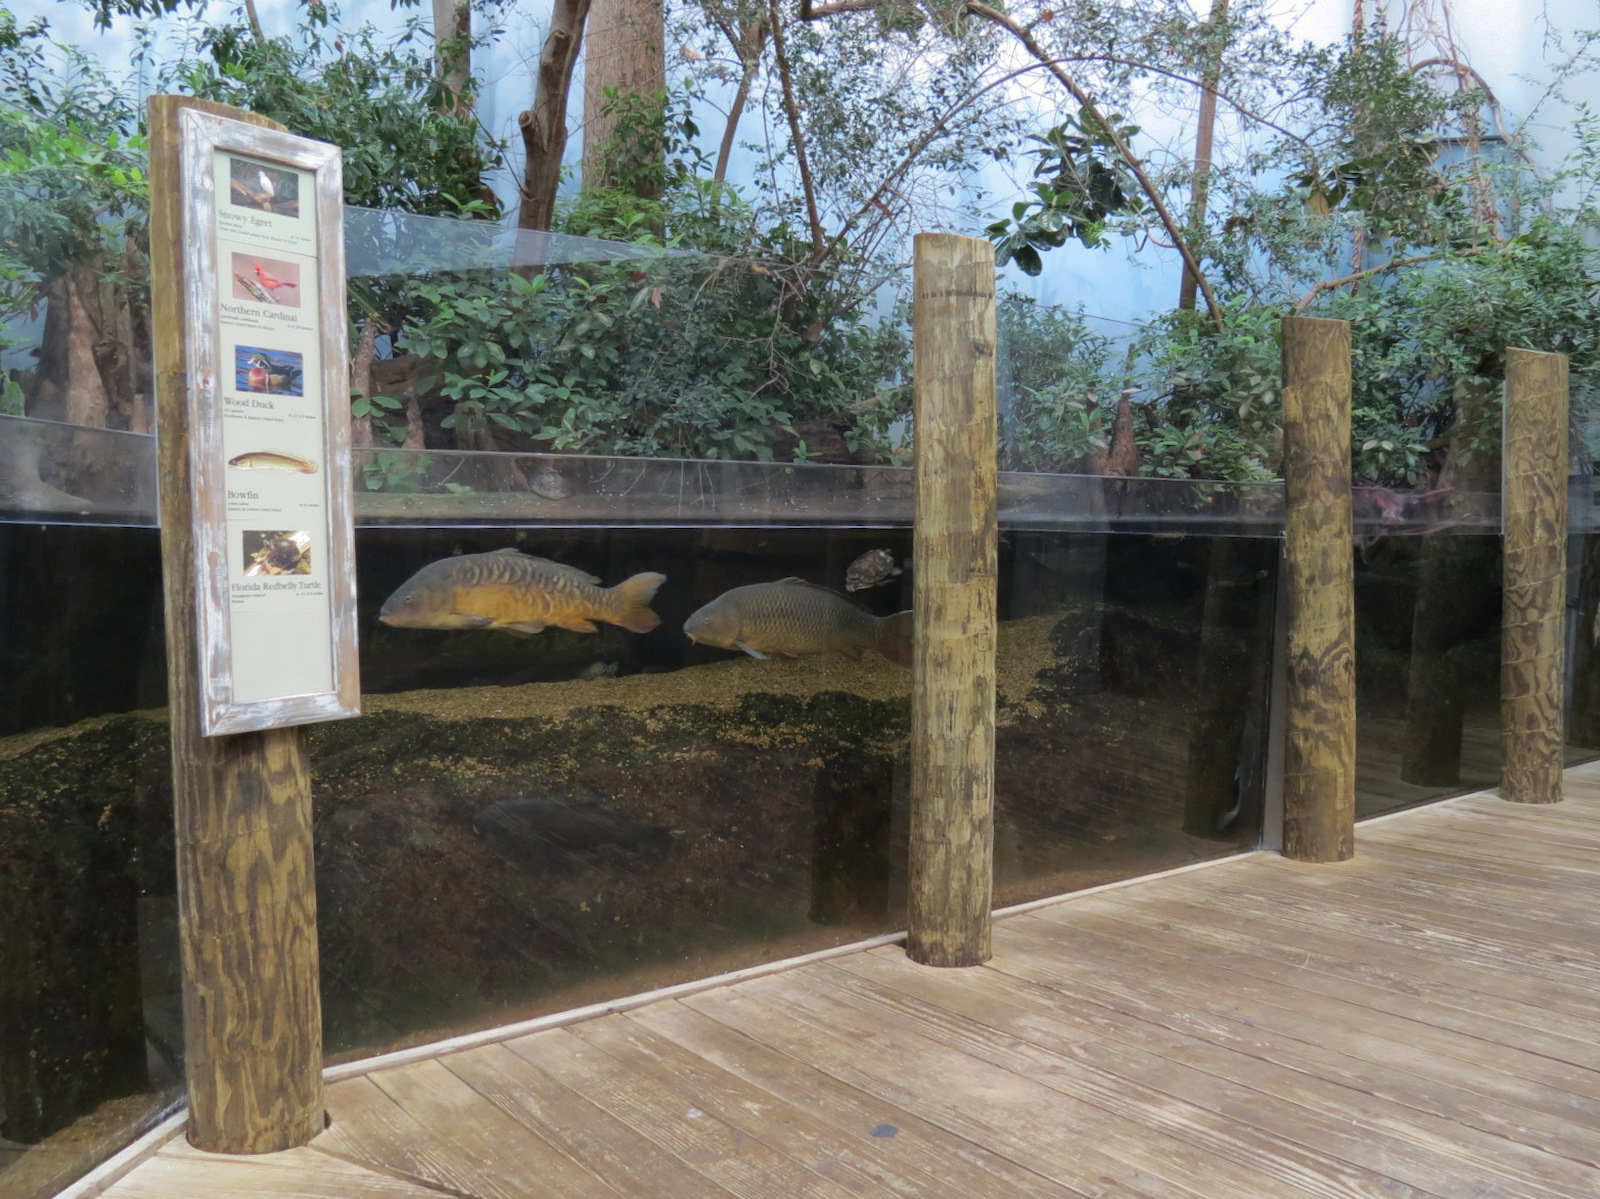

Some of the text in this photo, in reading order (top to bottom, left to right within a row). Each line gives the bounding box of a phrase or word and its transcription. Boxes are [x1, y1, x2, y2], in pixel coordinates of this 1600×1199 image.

[218, 209, 247, 224] Snowy
[251, 216, 272, 228] Egret
[220, 303, 260, 317] Northern
[263, 309, 298, 322] Cardinal
[224, 397, 274, 409] Wood Duck
[227, 490, 259, 500] Bowfin
[231, 581, 322, 591] Florida Redbelly Turtle
